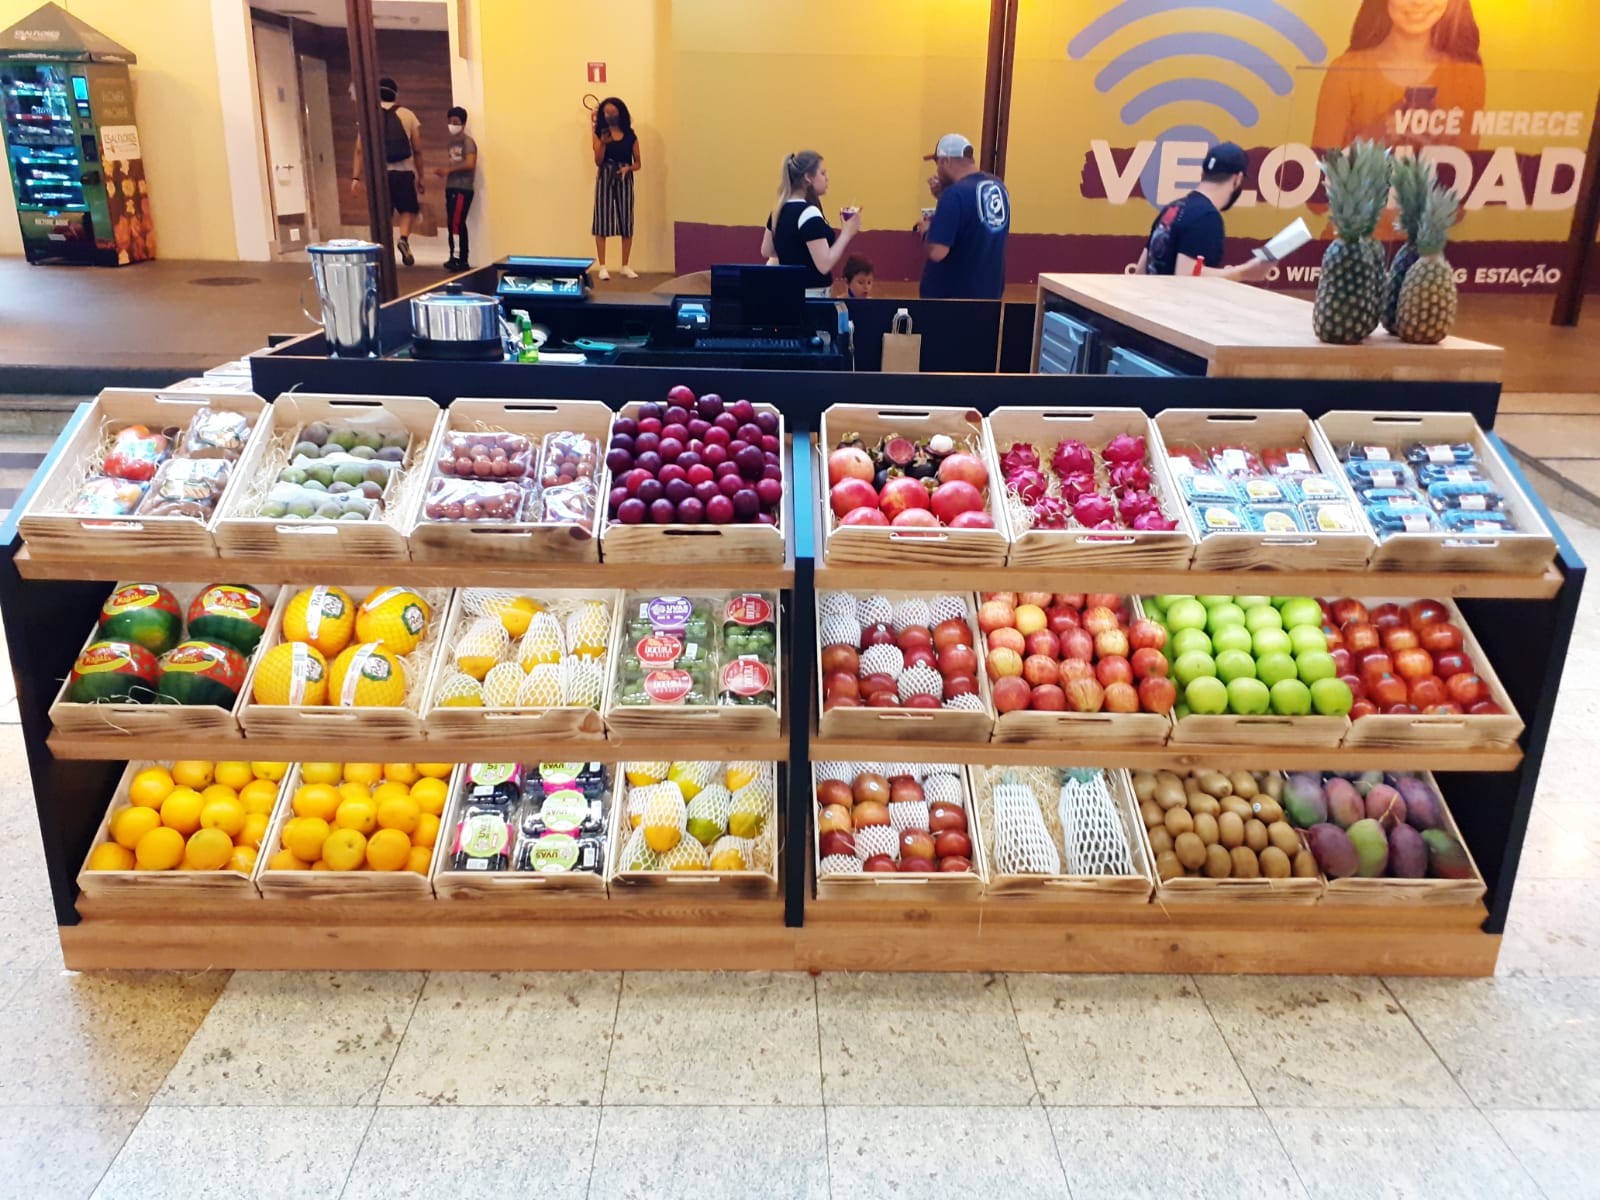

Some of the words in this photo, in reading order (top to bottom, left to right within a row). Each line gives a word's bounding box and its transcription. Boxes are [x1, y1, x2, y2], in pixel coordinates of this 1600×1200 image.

[1394, 106, 1464, 135] VOCÊ
[1471, 110, 1585, 137] MERECE
[1286, 266, 1322, 282] WIF
[1474, 264, 1561, 287] ESTAÇÃO
